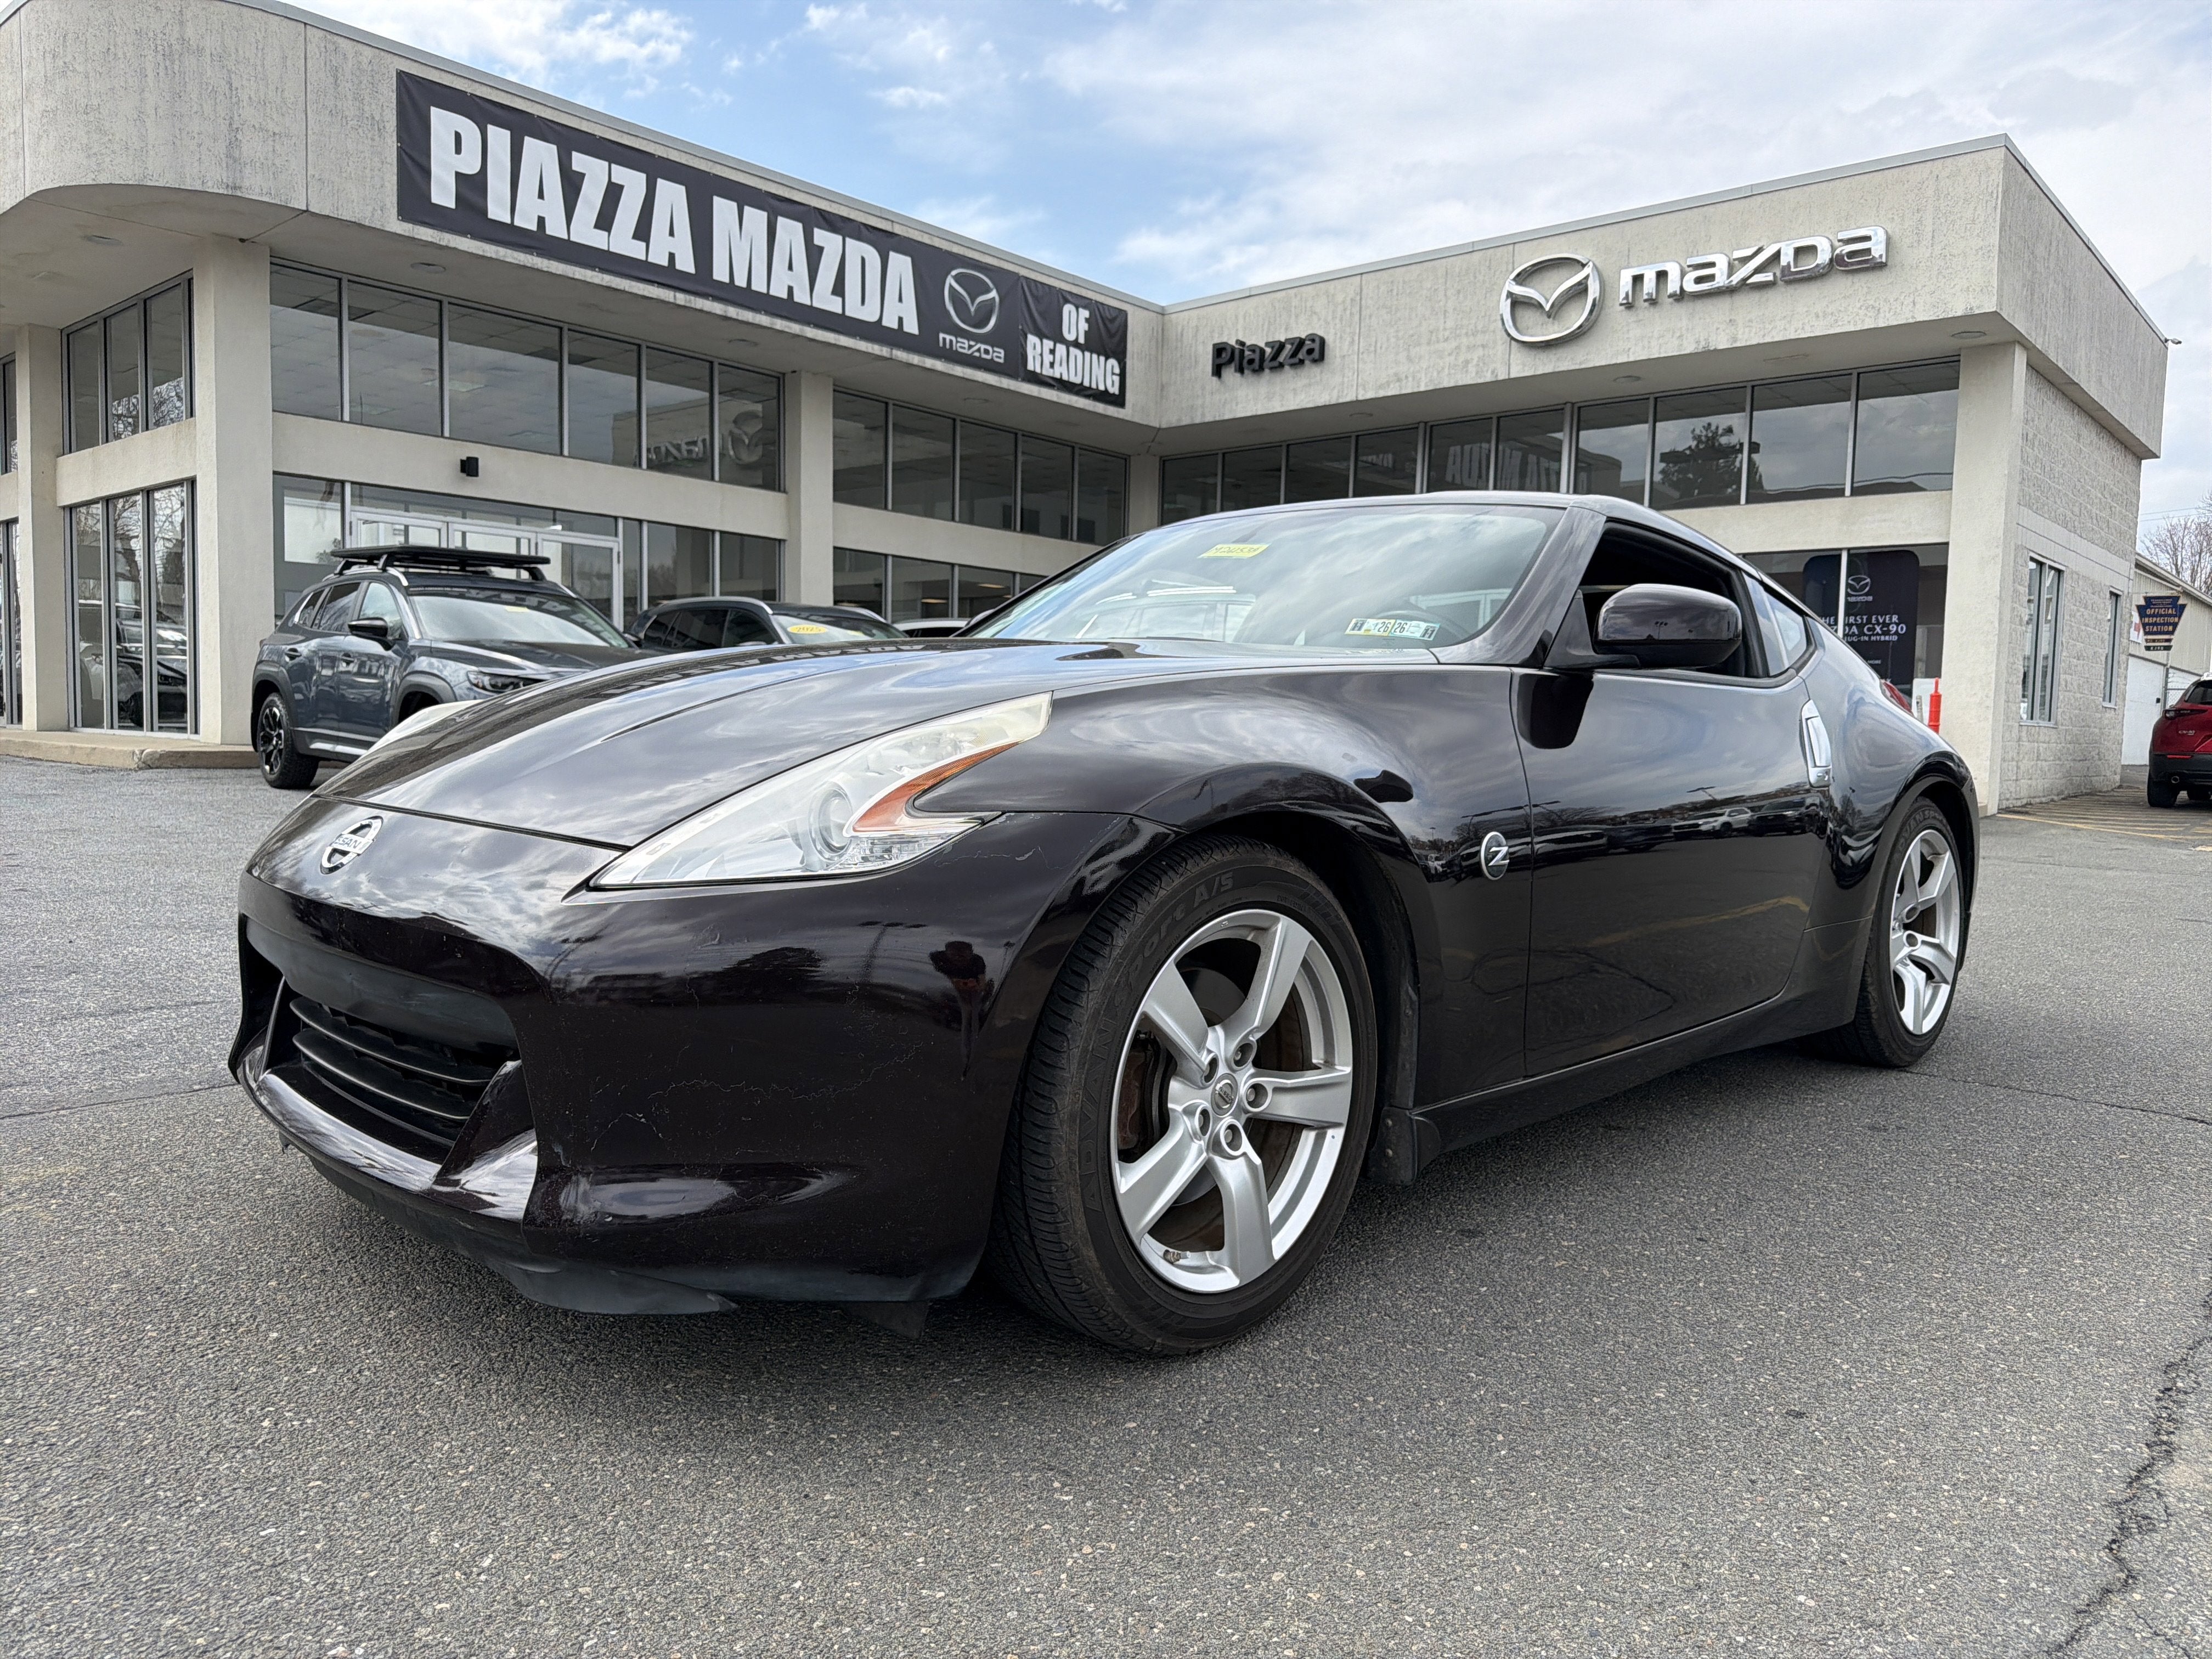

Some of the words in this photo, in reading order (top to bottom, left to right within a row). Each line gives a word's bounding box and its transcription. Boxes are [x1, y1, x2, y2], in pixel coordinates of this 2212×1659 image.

[430, 106, 696, 274] PIAZZA
[713, 195, 919, 335] MAZDA
[1619, 225, 1889, 307] mazda
[1062, 303, 1090, 344] OF
[939, 332, 1005, 363] mazda
[1026, 334, 1120, 395] READING
[1211, 333, 1325, 379] Piazza
[1378, 621, 1391, 633] 26
[1393, 622, 1408, 633] 26
[1821, 616, 1835, 625] HE
[1845, 615, 1868, 624] IRST
[1872, 614, 1899, 623] EVER
[1864, 623, 1906, 635] CX-90
[1488, 847, 1510, 866] Z
[1193, 871, 1233, 908] A/S
